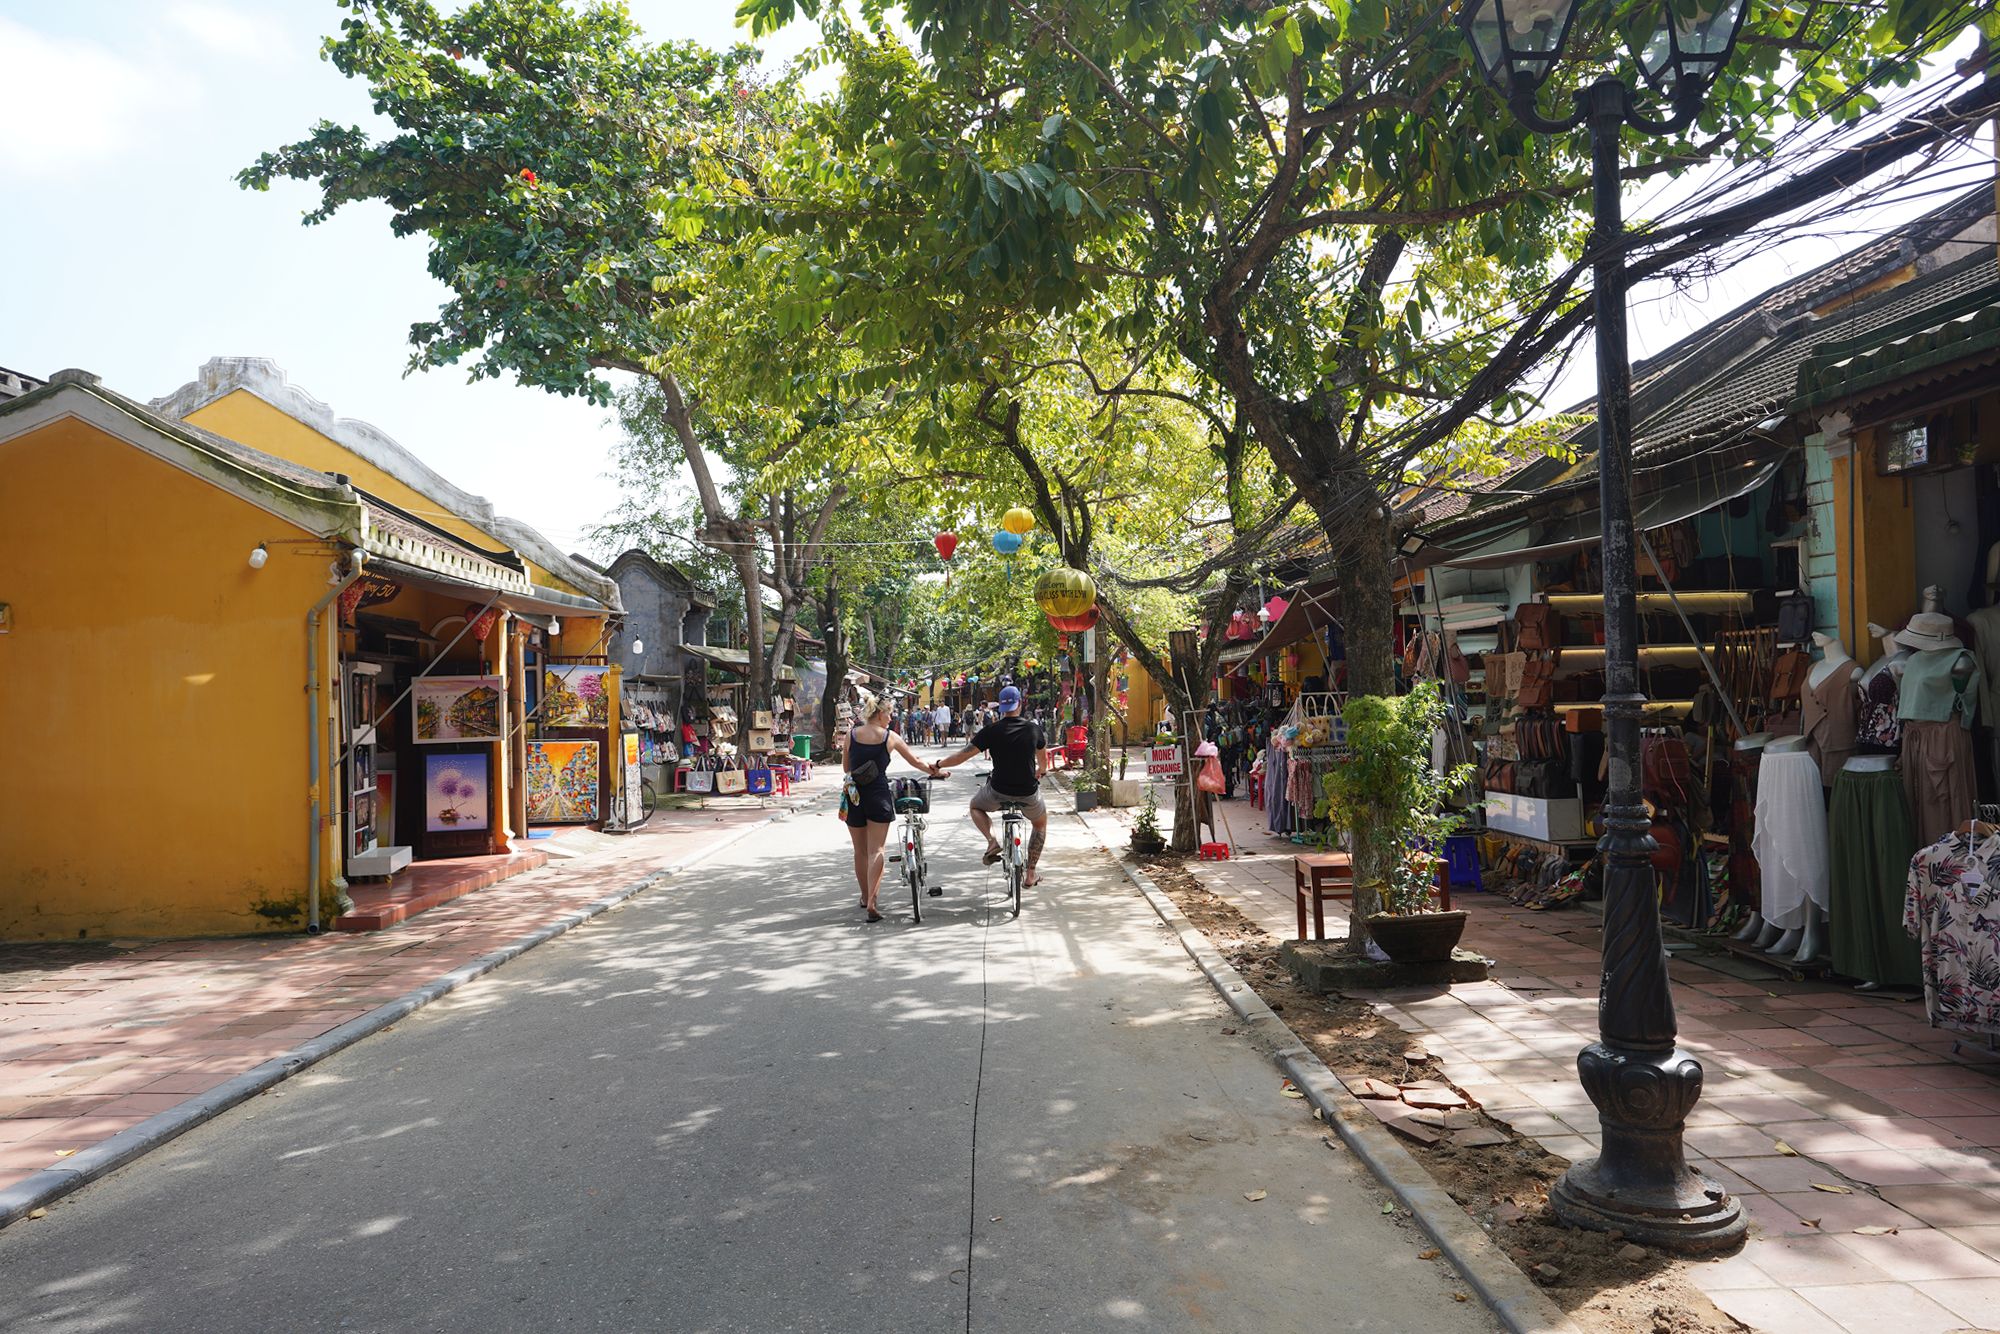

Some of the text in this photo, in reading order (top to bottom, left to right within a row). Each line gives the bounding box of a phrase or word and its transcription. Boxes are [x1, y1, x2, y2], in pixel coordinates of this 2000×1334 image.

[377, 584, 396, 598] 50
[1151, 749, 1175, 761] MONEY
[1148, 763, 1181, 774] EXCHANGE
